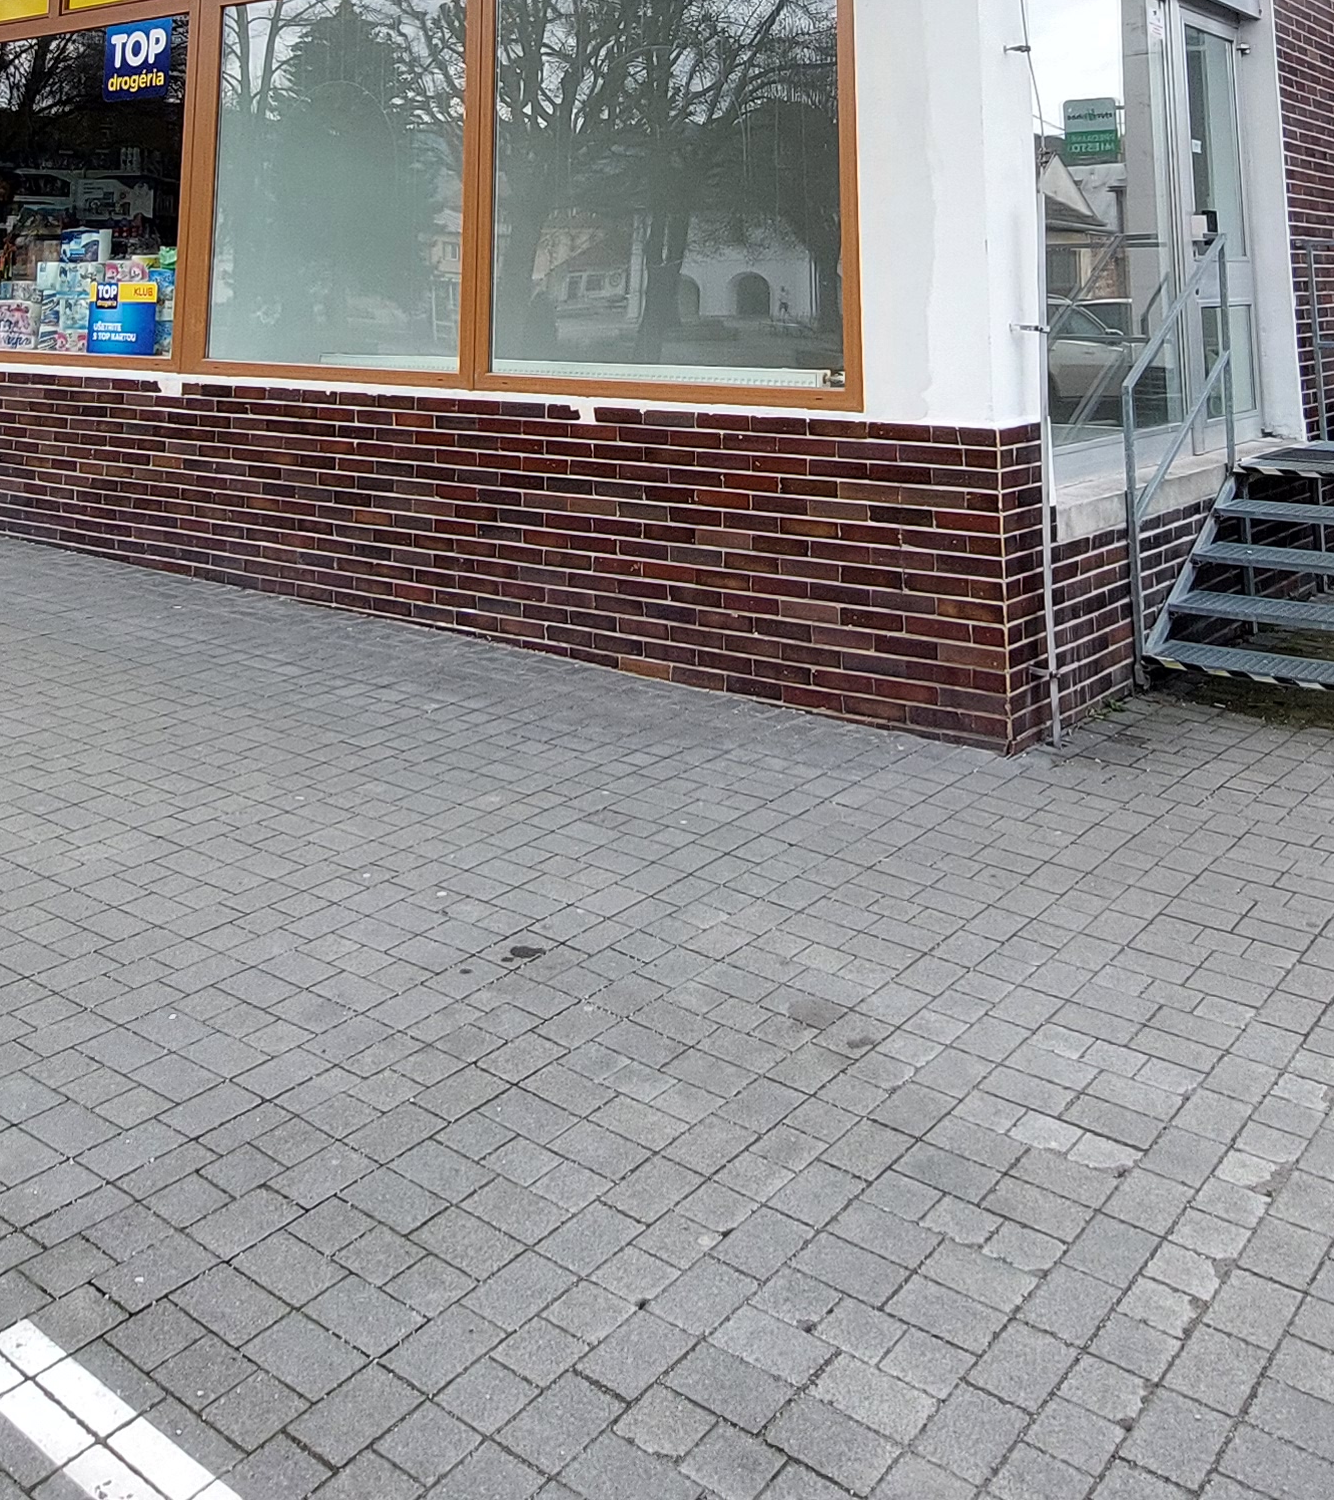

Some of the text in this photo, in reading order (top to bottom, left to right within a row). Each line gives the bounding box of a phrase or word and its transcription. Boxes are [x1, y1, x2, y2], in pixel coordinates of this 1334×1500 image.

[111, 27, 167, 69] TOP
[107, 68, 164, 93] drogéria
[98, 285, 117, 298] TOP
[134, 288, 153, 296] KLUB
[98, 332, 110, 340] TOP
